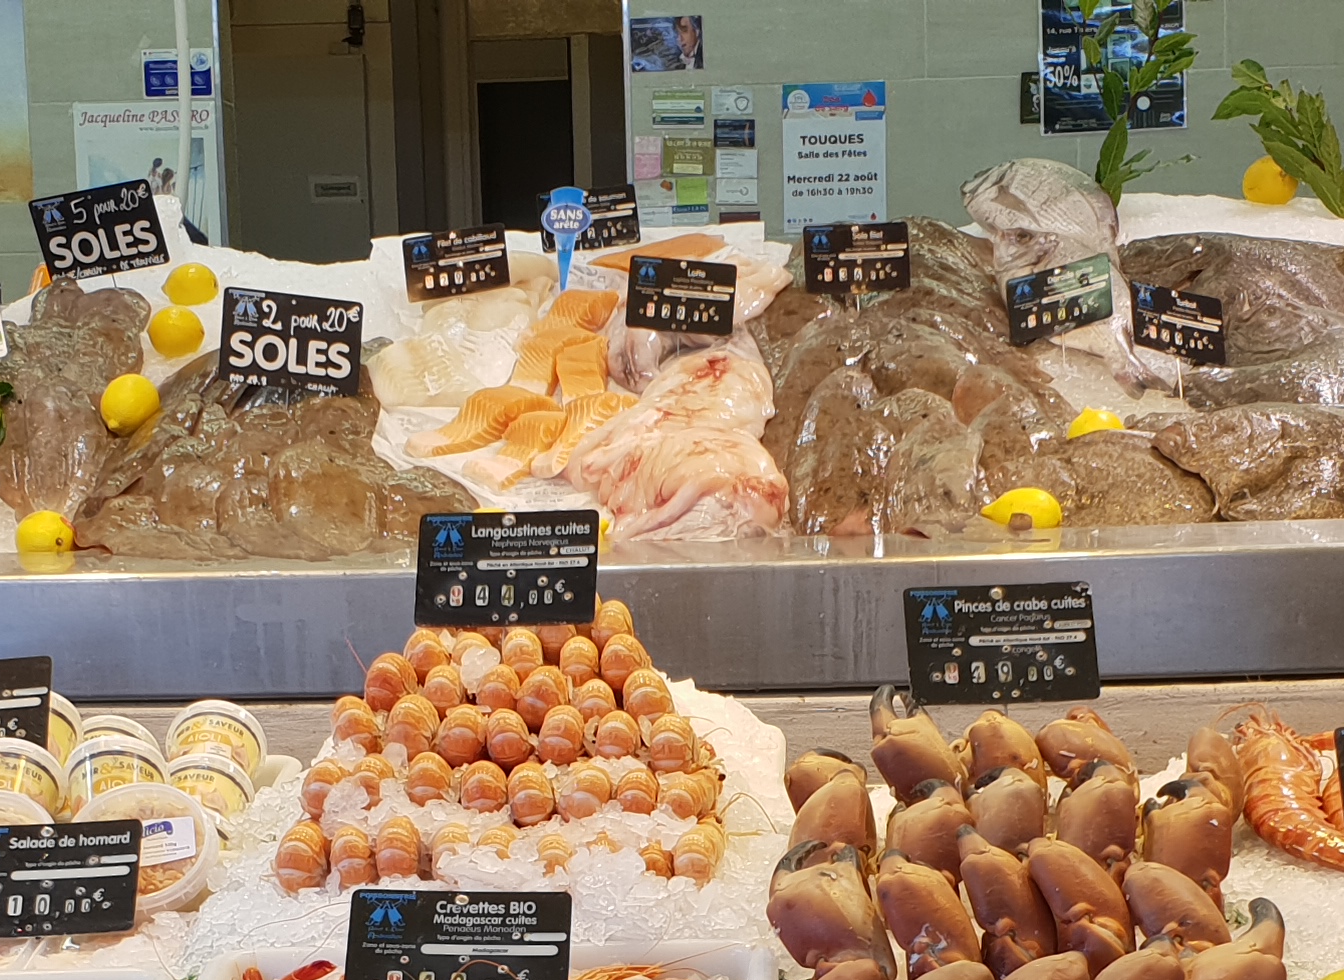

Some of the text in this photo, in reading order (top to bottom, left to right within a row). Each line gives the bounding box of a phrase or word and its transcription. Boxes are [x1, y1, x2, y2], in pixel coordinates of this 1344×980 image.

[1046, 66, 1078, 88] 50%
[79, 109, 145, 127] Jacqueline
[800, 134, 864, 145] TOUQUES
[798, 149, 867, 159] Salle des Fêtes
[787, 174, 834, 184] Mercredi
[854, 172, 878, 181] août
[792, 189, 803, 197] de
[807, 188, 834, 196] 16h30
[846, 187, 873, 195] 19h30
[70, 197, 87, 223] 5
[550, 210, 583, 220] SANS
[554, 221, 579, 229] arête
[49, 220, 157, 269] SOLES
[262, 300, 360, 332] 2 20€
[229, 331, 351, 378] SOLES
[472, 523, 590, 540] Langoustines cuites
[954, 596, 1086, 613] Pinces de crabe cuites
[991, 613, 1050, 623] Cancer Pagurus
[209, 719, 244, 736] SAVEUR
[188, 732, 221, 742] AIOLI
[177, 773, 215, 782] SAVEUR
[9, 832, 130, 849] Salade de homard
[436, 901, 536, 914] Crevettes BIO
[434, 915, 537, 926] Madagascar cuites
